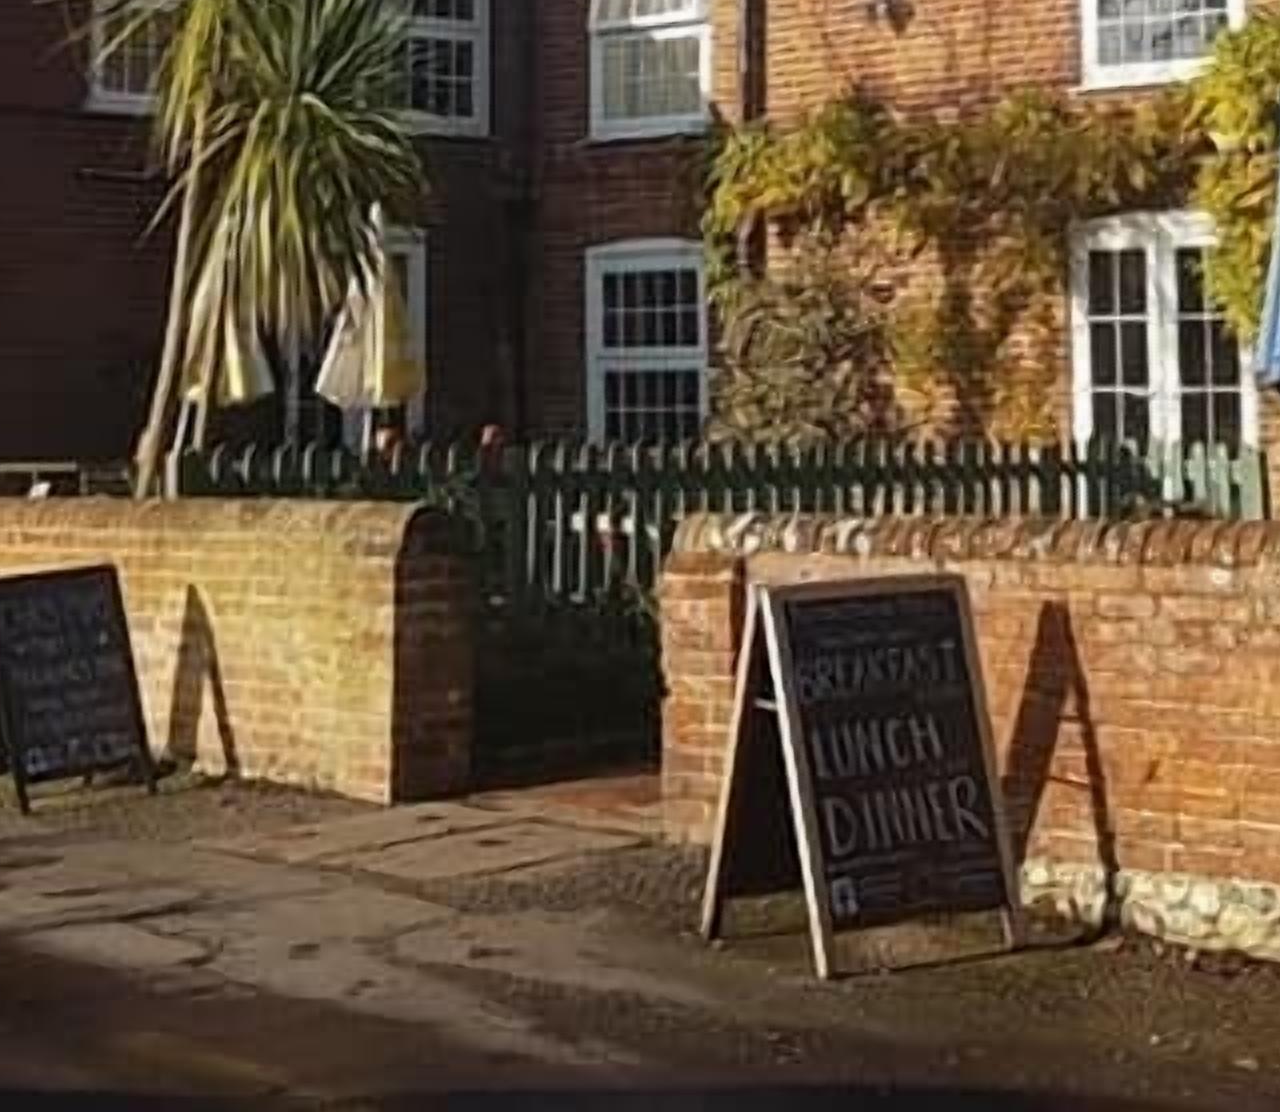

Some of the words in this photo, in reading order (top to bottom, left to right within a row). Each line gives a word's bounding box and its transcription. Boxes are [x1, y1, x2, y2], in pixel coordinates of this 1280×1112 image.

[796, 636, 958, 704] BREAKFAST
[810, 712, 944, 779] LUNCH
[821, 774, 989, 857] DINNER
